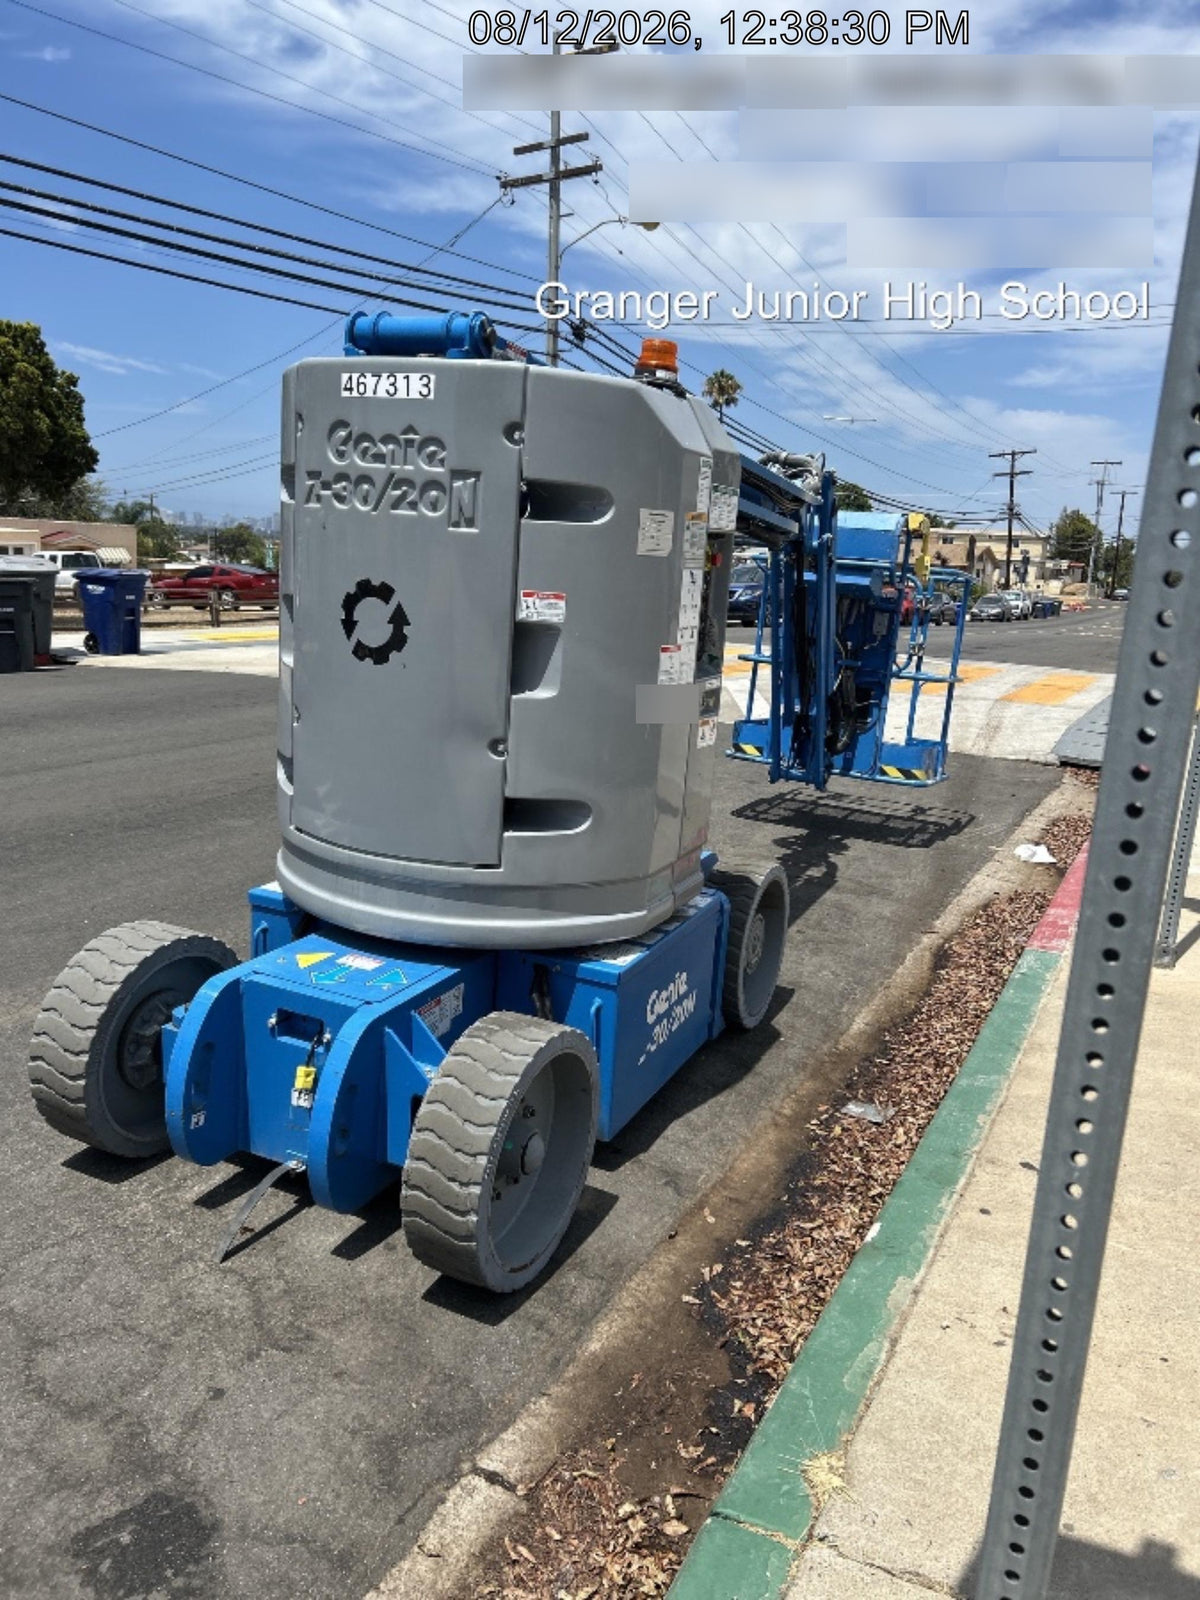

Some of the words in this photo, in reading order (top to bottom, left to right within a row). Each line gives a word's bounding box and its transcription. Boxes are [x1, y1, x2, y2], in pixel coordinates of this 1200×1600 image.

[343, 374, 432, 398] 467313
[328, 419, 447, 471] Genie
[646, 971, 688, 1025] Genie
